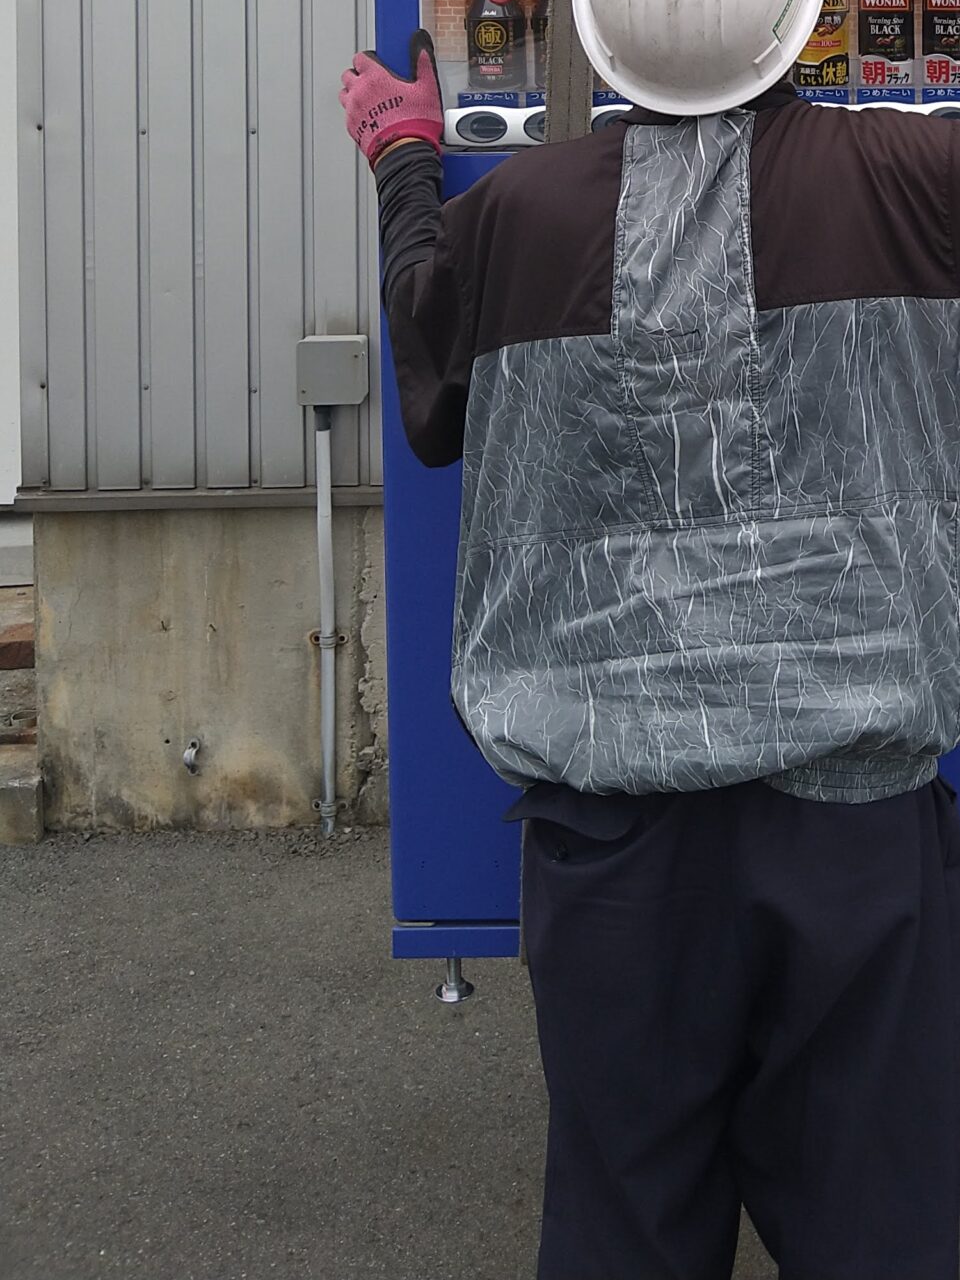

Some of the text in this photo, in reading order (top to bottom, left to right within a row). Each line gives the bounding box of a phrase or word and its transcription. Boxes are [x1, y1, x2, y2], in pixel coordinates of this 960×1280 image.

[478, 25, 502, 48] 極
[870, 24, 901, 35] BLACK
[478, 56, 504, 65] BLACK
[926, 59, 950, 84] 朝
[862, 60, 886, 85] 朝
[886, 73, 910, 84] ブラック
[368, 95, 404, 119] GRIP
